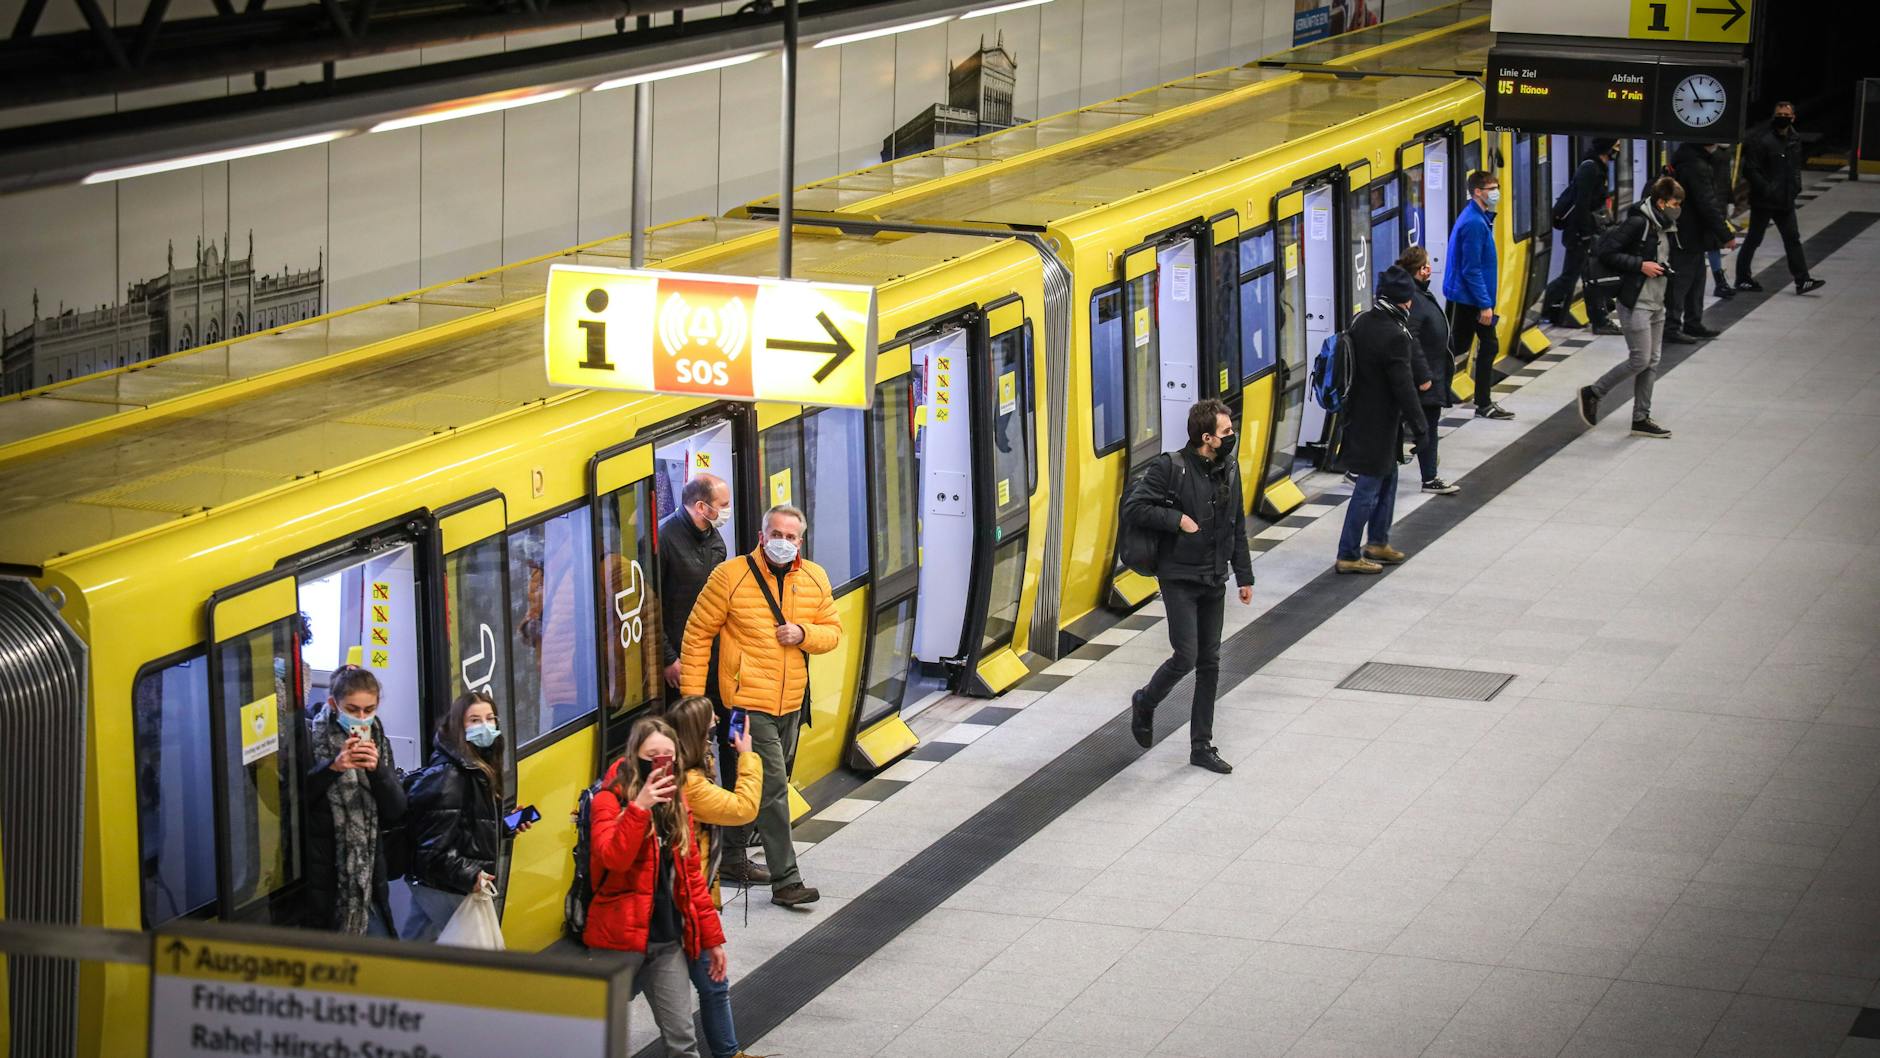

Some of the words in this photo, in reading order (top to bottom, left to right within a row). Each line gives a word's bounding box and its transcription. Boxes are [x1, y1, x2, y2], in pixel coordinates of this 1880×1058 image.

[1499, 68, 1519, 77] Linie
[1521, 69, 1537, 78] Ziel
[1611, 73, 1644, 84] Abfahrt
[1498, 80, 1514, 94] U5
[1520, 84, 1549, 95] Hönow
[1607, 89, 1617, 99] in
[675, 358, 729, 386] SOS
[195, 945, 307, 986] Ausgang
[310, 957, 360, 985] exit
[191, 984, 425, 1031] Friedrich-List-Ufer
